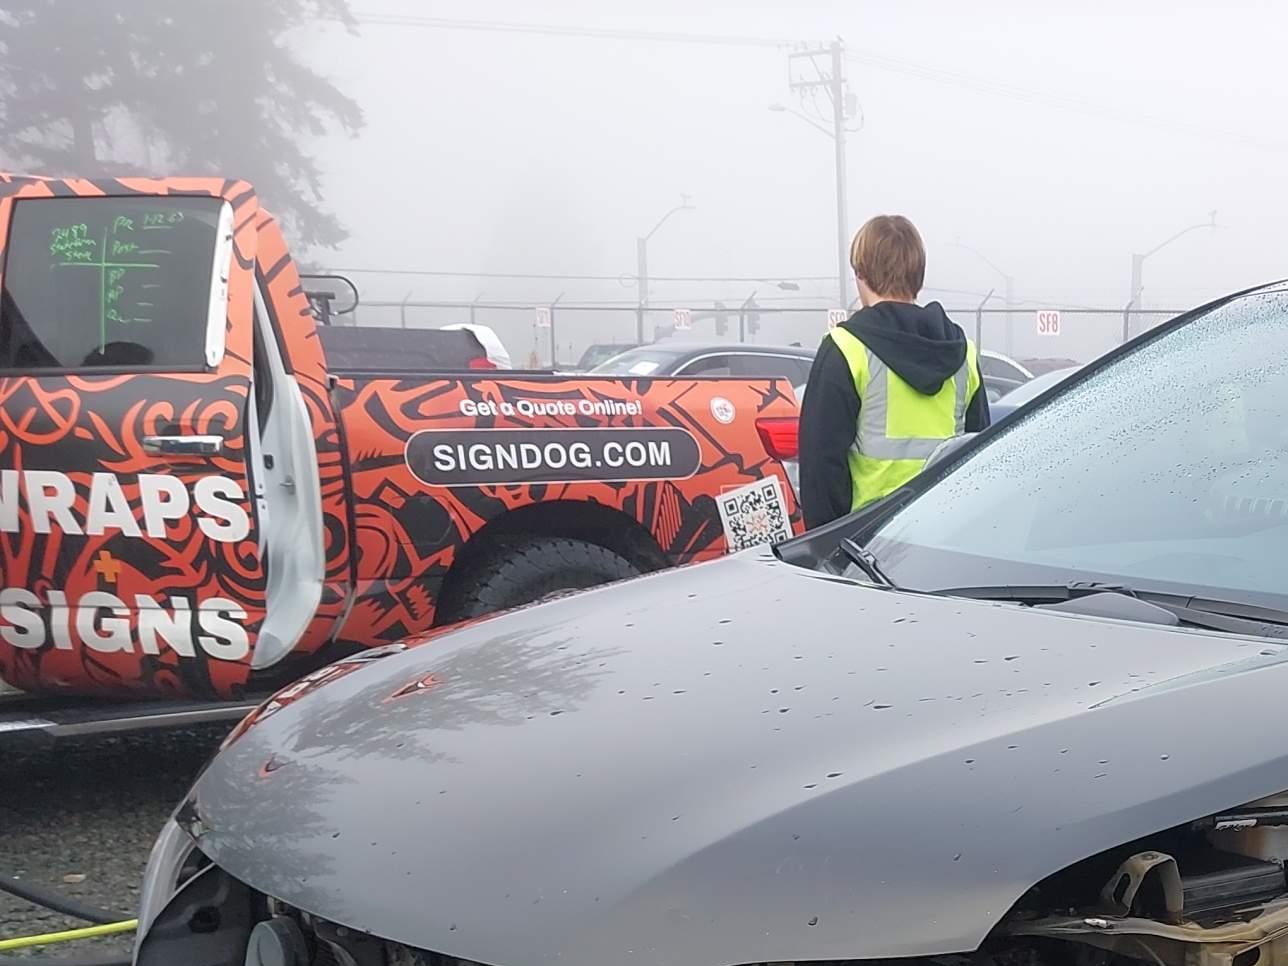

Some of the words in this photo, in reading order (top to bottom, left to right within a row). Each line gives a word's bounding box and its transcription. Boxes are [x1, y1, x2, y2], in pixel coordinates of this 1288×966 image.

[1039, 313, 1058, 333] SF8
[459, 399, 498, 417] Get
[501, 402, 515, 416] a
[516, 400, 575, 417] Quote
[578, 399, 642, 416] Online!
[433, 441, 671, 471] SIGNDOG.COM
[0, 588, 250, 660] SIGNS
